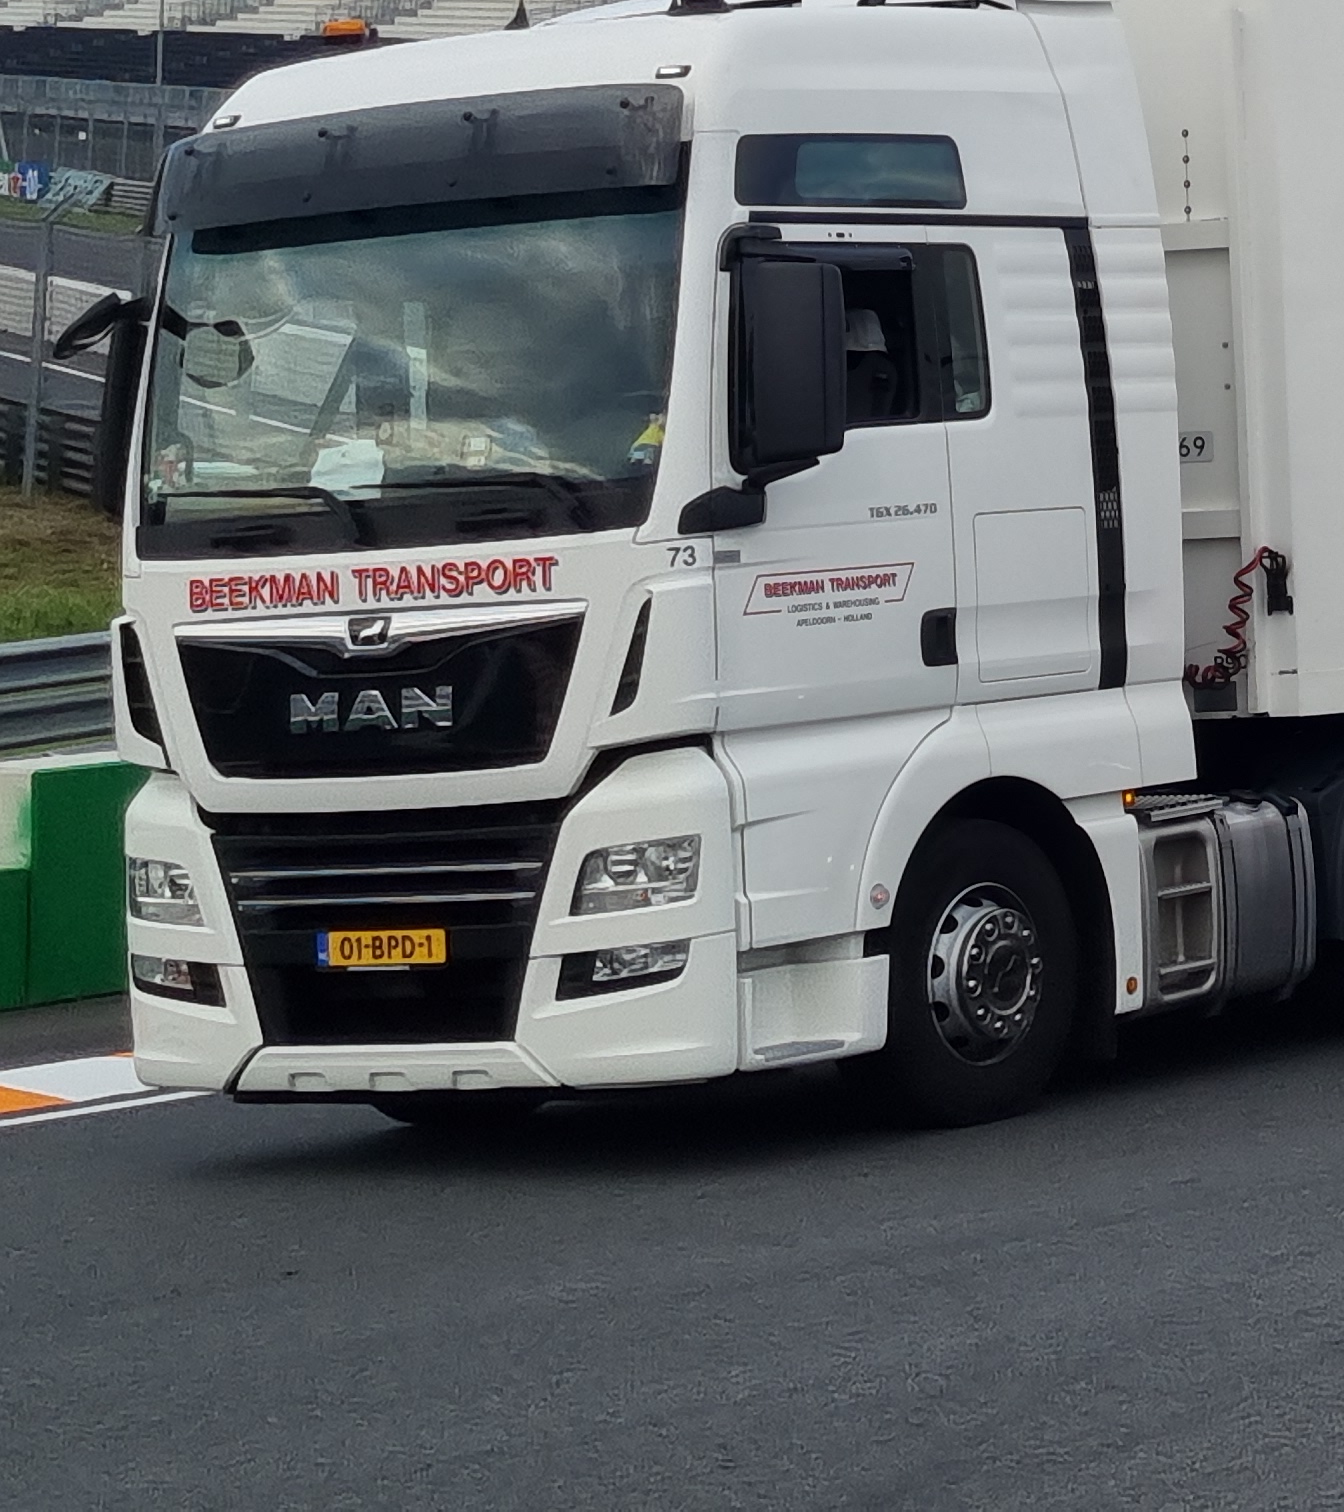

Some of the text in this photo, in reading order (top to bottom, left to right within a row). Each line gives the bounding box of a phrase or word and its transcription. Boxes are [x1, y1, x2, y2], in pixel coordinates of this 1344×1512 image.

[868, 502, 938, 518] TGX 26.470
[666, 545, 697, 567] 73
[188, 555, 558, 612] BEEKMAN TRANSPORT
[763, 572, 898, 599] BEEKMAN TRANSPORT
[787, 602, 823, 613] LOGISTICS
[833, 597, 880, 609] WAREHOUSING
[796, 616, 836, 627] APELDOORN
[843, 612, 873, 622] HOLLAND
[289, 685, 453, 734] MAN
[339, 934, 433, 960] 01-BPD-1
